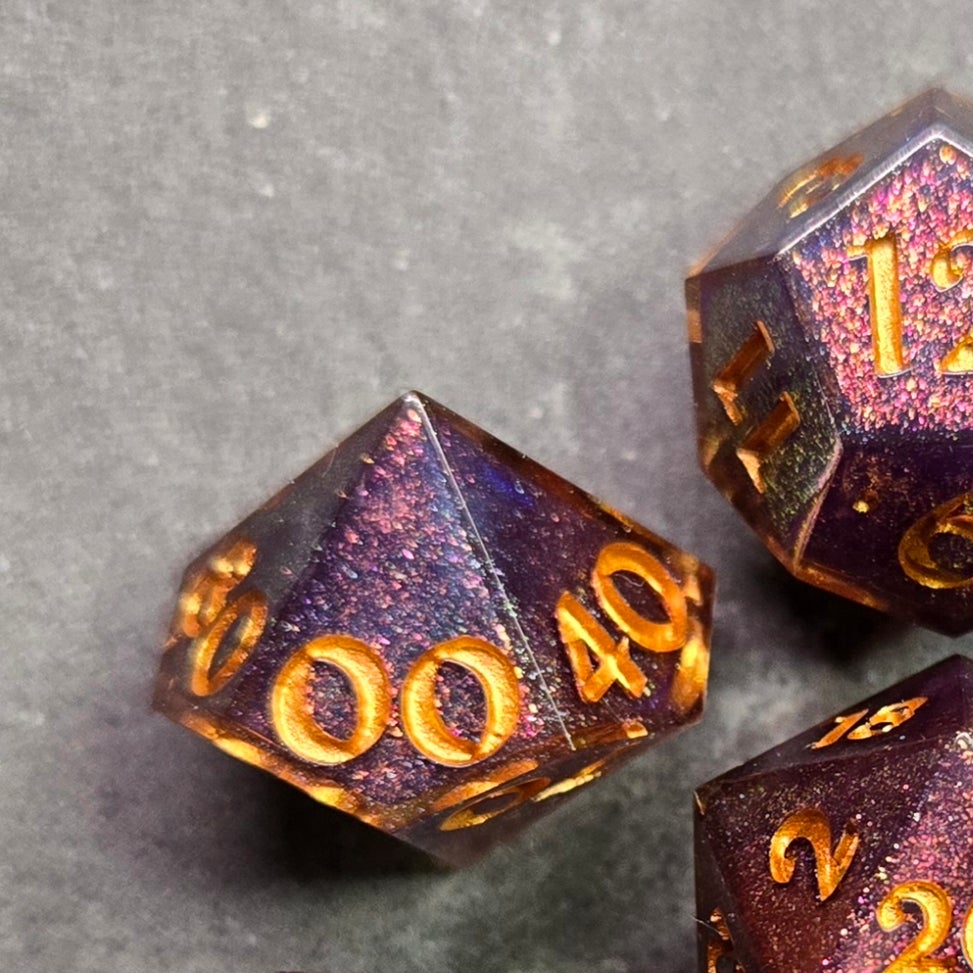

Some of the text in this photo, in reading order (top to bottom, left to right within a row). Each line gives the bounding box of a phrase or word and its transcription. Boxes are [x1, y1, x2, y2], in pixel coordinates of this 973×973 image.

[556, 541, 690, 703] 40
[271, 634, 520, 769] 00
[769, 808, 860, 901] 2
